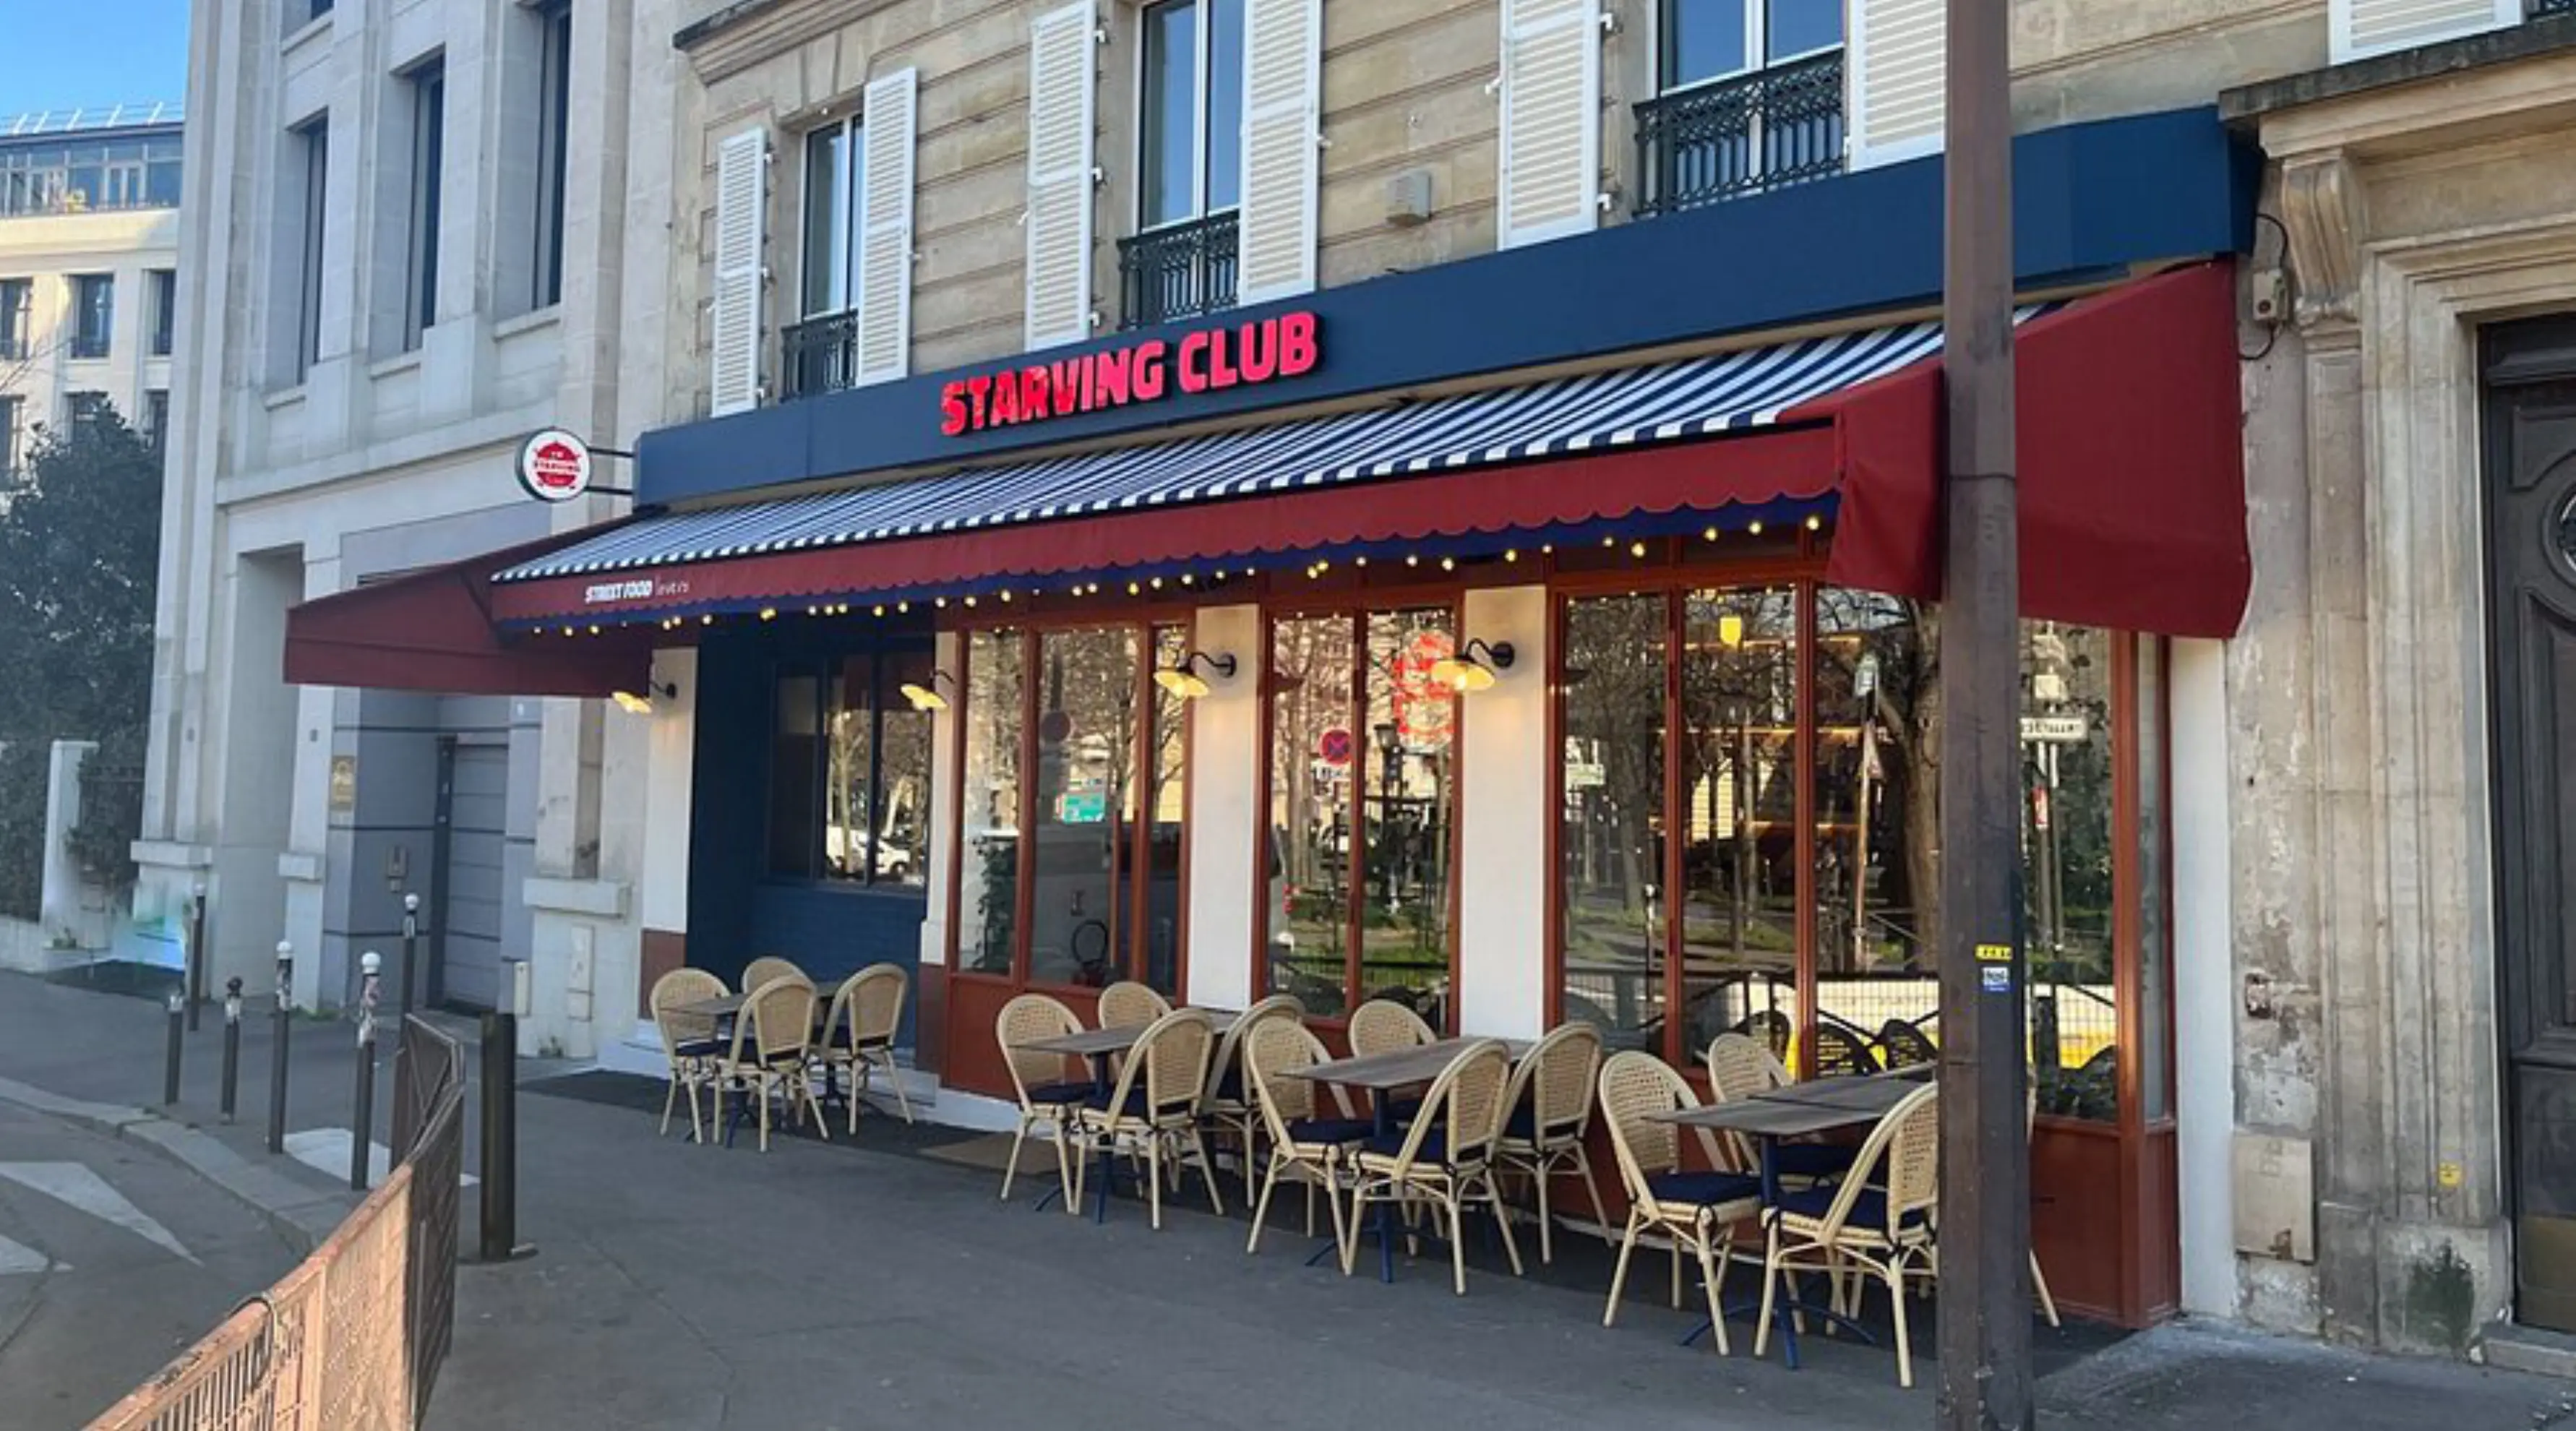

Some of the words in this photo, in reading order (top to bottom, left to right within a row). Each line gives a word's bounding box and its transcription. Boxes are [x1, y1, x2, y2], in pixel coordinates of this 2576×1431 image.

[941, 340, 1164, 435] STARVING
[1179, 311, 1318, 392] CLUB
[585, 583, 624, 603] STREET
[624, 580, 653, 598] FOOD
